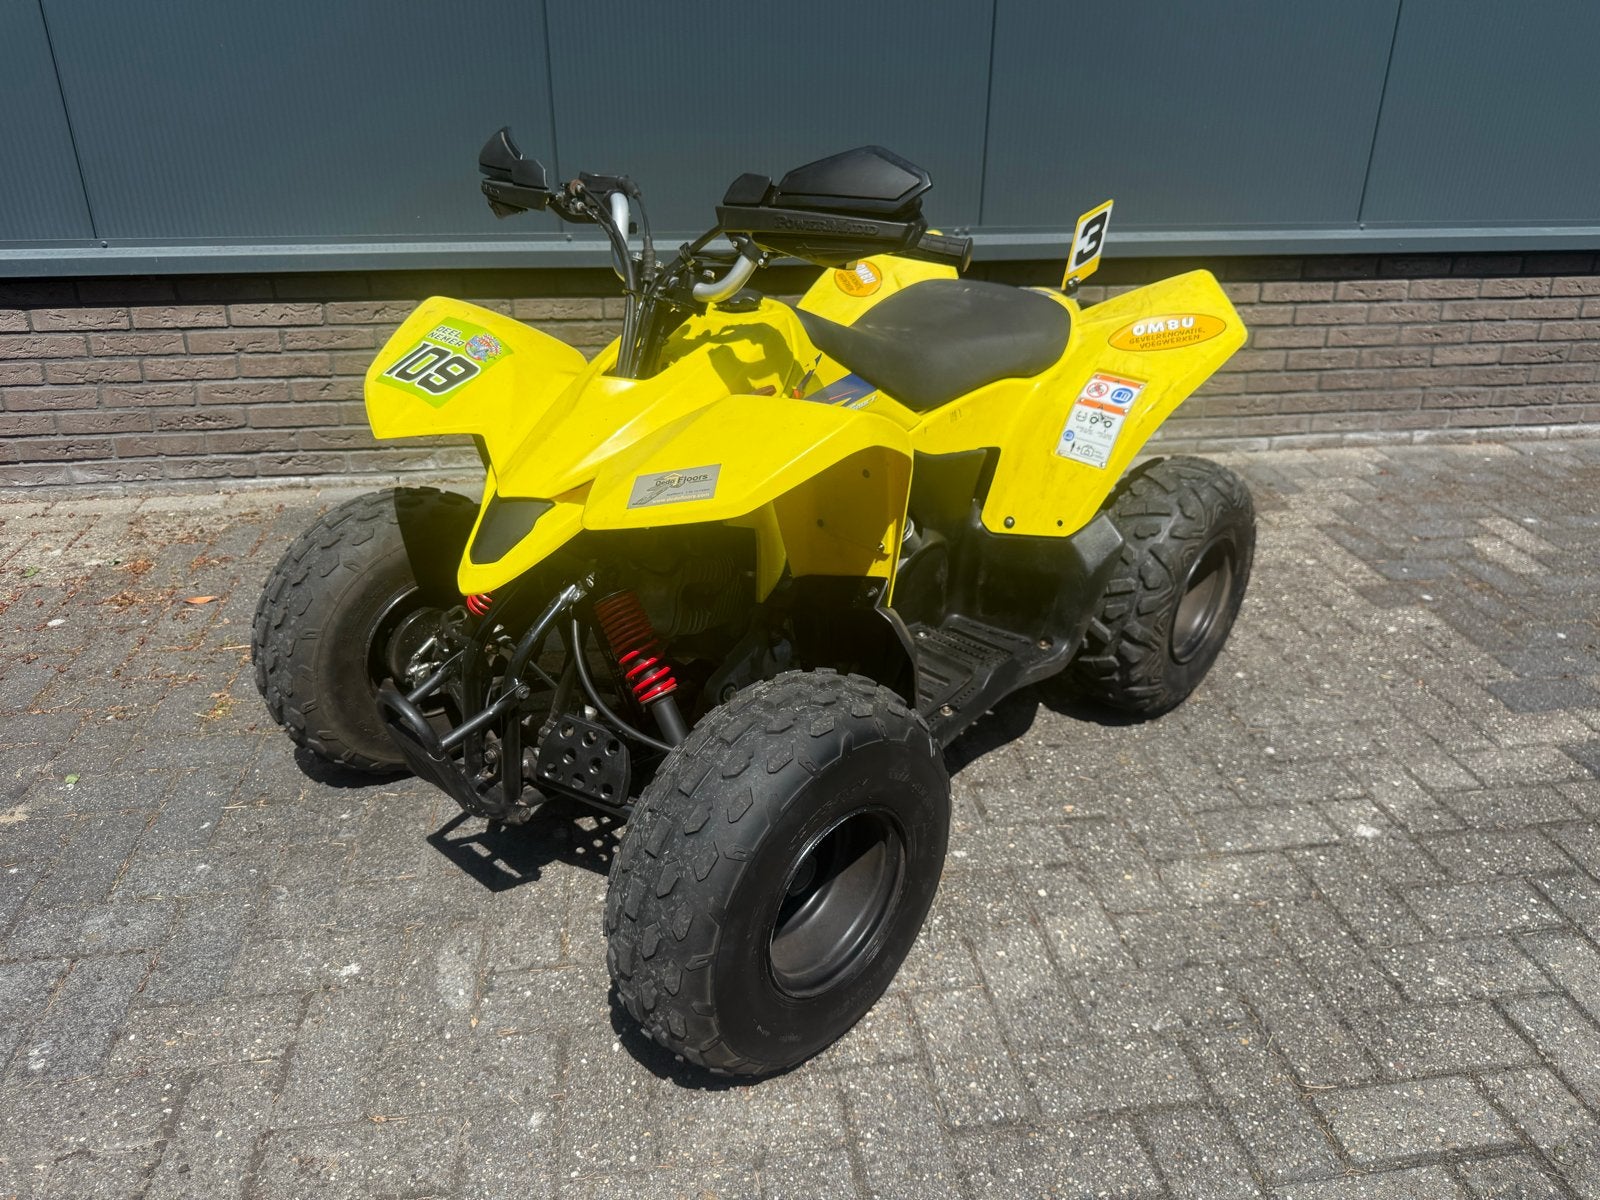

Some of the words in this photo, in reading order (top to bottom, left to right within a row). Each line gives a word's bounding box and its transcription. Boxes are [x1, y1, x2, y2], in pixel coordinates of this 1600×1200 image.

[1075, 211, 1107, 267] 3
[436, 325, 463, 338] DEEL
[1132, 316, 1195, 336] OMBU
[427, 332, 466, 348] NEMER
[1139, 334, 1200, 349] VOEGWERKEN
[383, 341, 481, 395] 109
[678, 473, 708, 484] Floors
